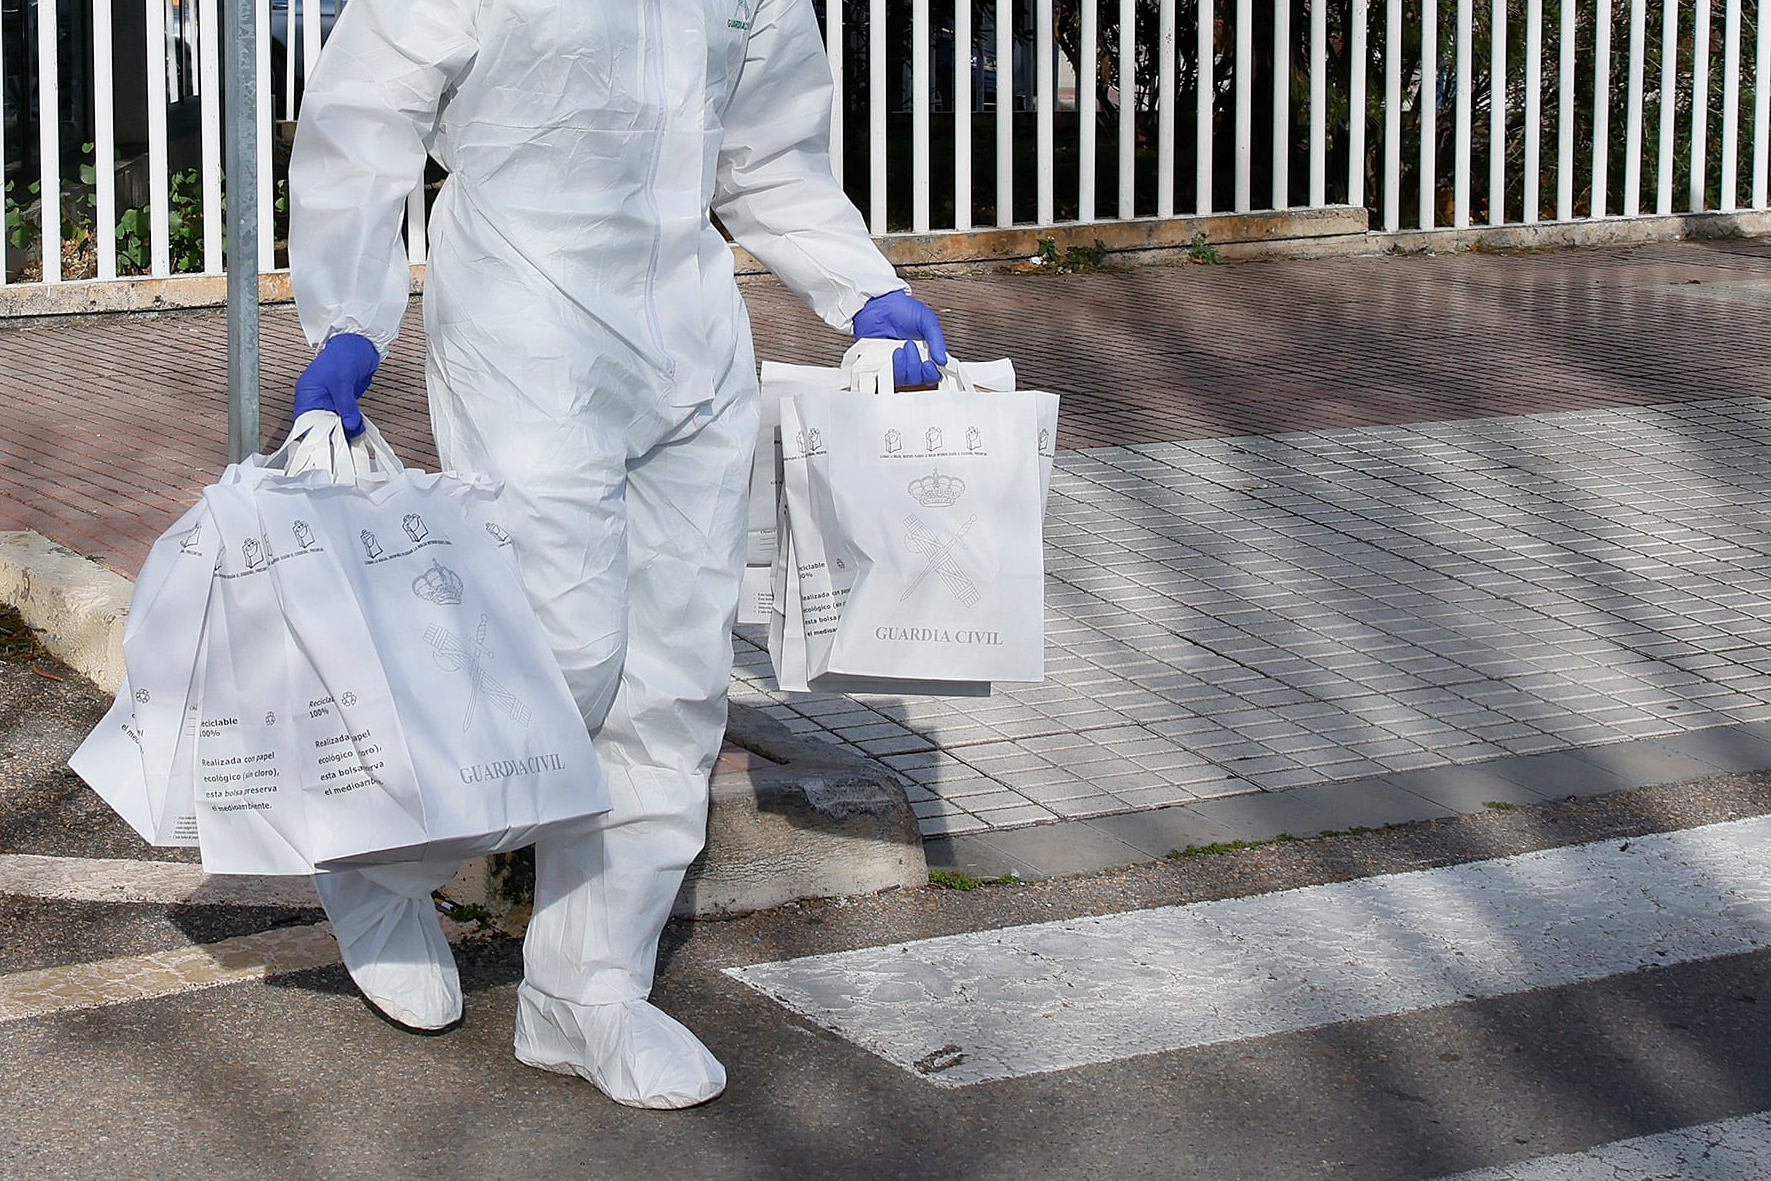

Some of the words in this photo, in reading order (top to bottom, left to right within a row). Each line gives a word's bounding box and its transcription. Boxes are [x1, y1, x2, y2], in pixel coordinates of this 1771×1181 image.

[818, 615, 837, 624] bolsa
[875, 626, 951, 643] GUARDIA
[955, 630, 1004, 646] CIVIL
[309, 707, 329, 719] 100%
[315, 733, 350, 749] Realizada
[201, 756, 242, 767] Realizada
[318, 751, 353, 766] ecológico
[203, 772, 241, 784] ecológico
[254, 768, 280, 778] cloro),
[320, 772, 337, 782] esta
[338, 764, 363, 776] bolsa
[459, 759, 529, 785] GUARDIA
[527, 753, 566, 775] CIVIL
[206, 789, 223, 799] esta
[224, 788, 243, 798] bolsa
[324, 786, 332, 796] el
